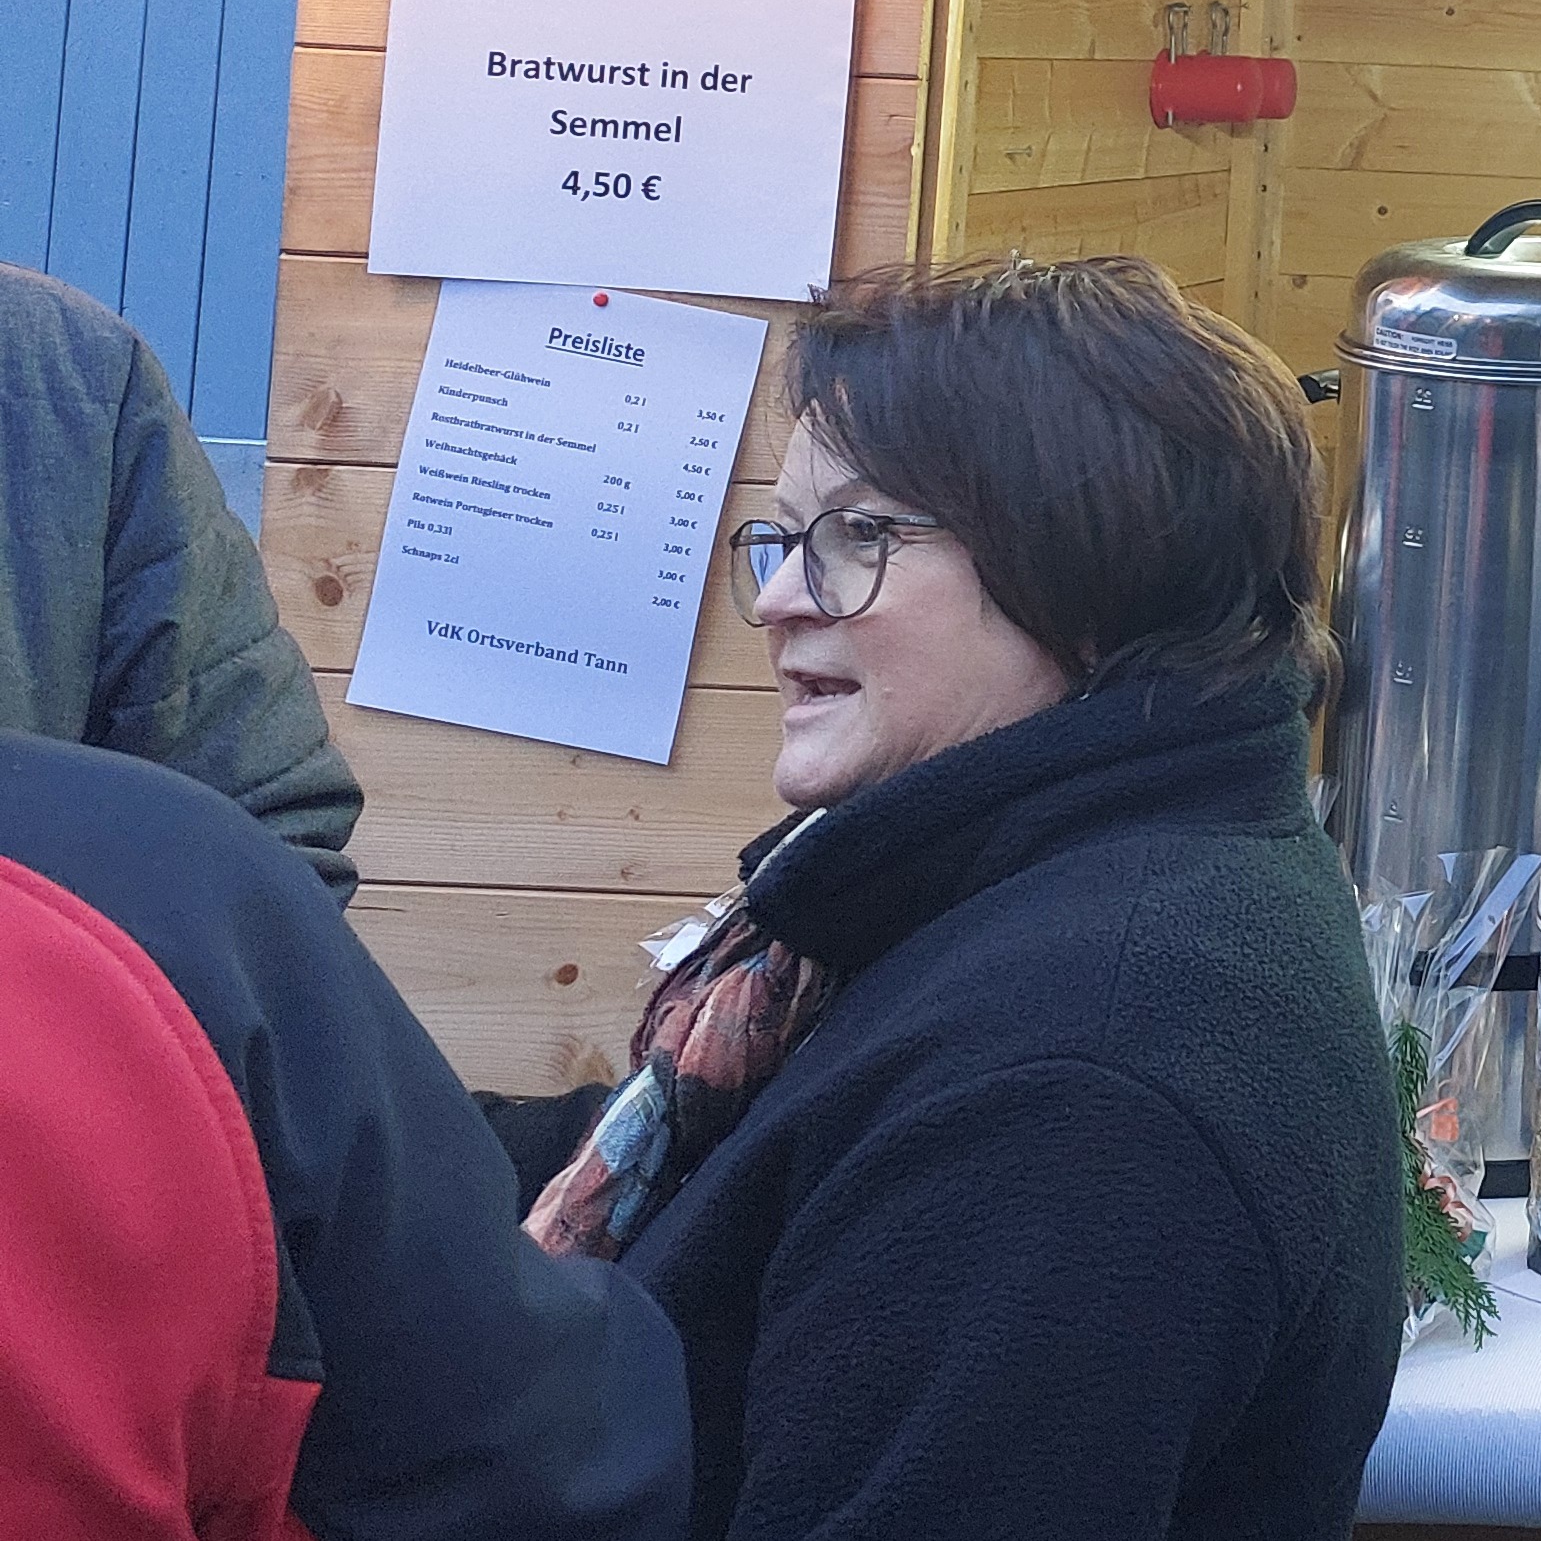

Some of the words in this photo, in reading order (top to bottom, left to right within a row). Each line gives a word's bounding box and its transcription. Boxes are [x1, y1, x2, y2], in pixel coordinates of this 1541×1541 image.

[487, 50, 651, 87] Bratwurst
[660, 61, 689, 90] in
[700, 64, 753, 94] der
[549, 109, 682, 143] Semmel
[561, 170, 632, 202] 4,50
[640, 174, 662, 202] €
[547, 326, 646, 363] Preisliste
[437, 384, 509, 407] Kinderpunsch
[616, 421, 634, 433] 0,2
[689, 435, 710, 448] 2,50
[624, 394, 641, 406] 0,2
[696, 408, 717, 421] 3,50
[425, 438, 518, 466] Weihnachtsgebäck
[602, 474, 624, 487] 200
[675, 489, 696, 502] 5,00
[524, 430, 536, 441] in
[536, 433, 556, 445] der
[555, 436, 597, 454] Semmel
[682, 462, 703, 475] 4,50
[411, 491, 454, 509] Rotwein
[454, 500, 515, 521] Portugieser
[514, 513, 554, 529] trocken
[590, 527, 613, 541] 0,25
[662, 542, 684, 555] 3,00
[418, 464, 469, 484] Weißwein
[470, 475, 512, 494] Riesling
[512, 485, 552, 501] trocken
[596, 501, 620, 514] 0,25
[668, 515, 690, 528] 3,00
[401, 544, 443, 562] Schnaps
[651, 595, 673, 608] 2,00
[406, 518, 426, 531] Pils
[657, 569, 678, 582] 3,00
[426, 619, 465, 642] VdK
[466, 628, 580, 665] Ortsverband
[583, 651, 629, 675] Tann
